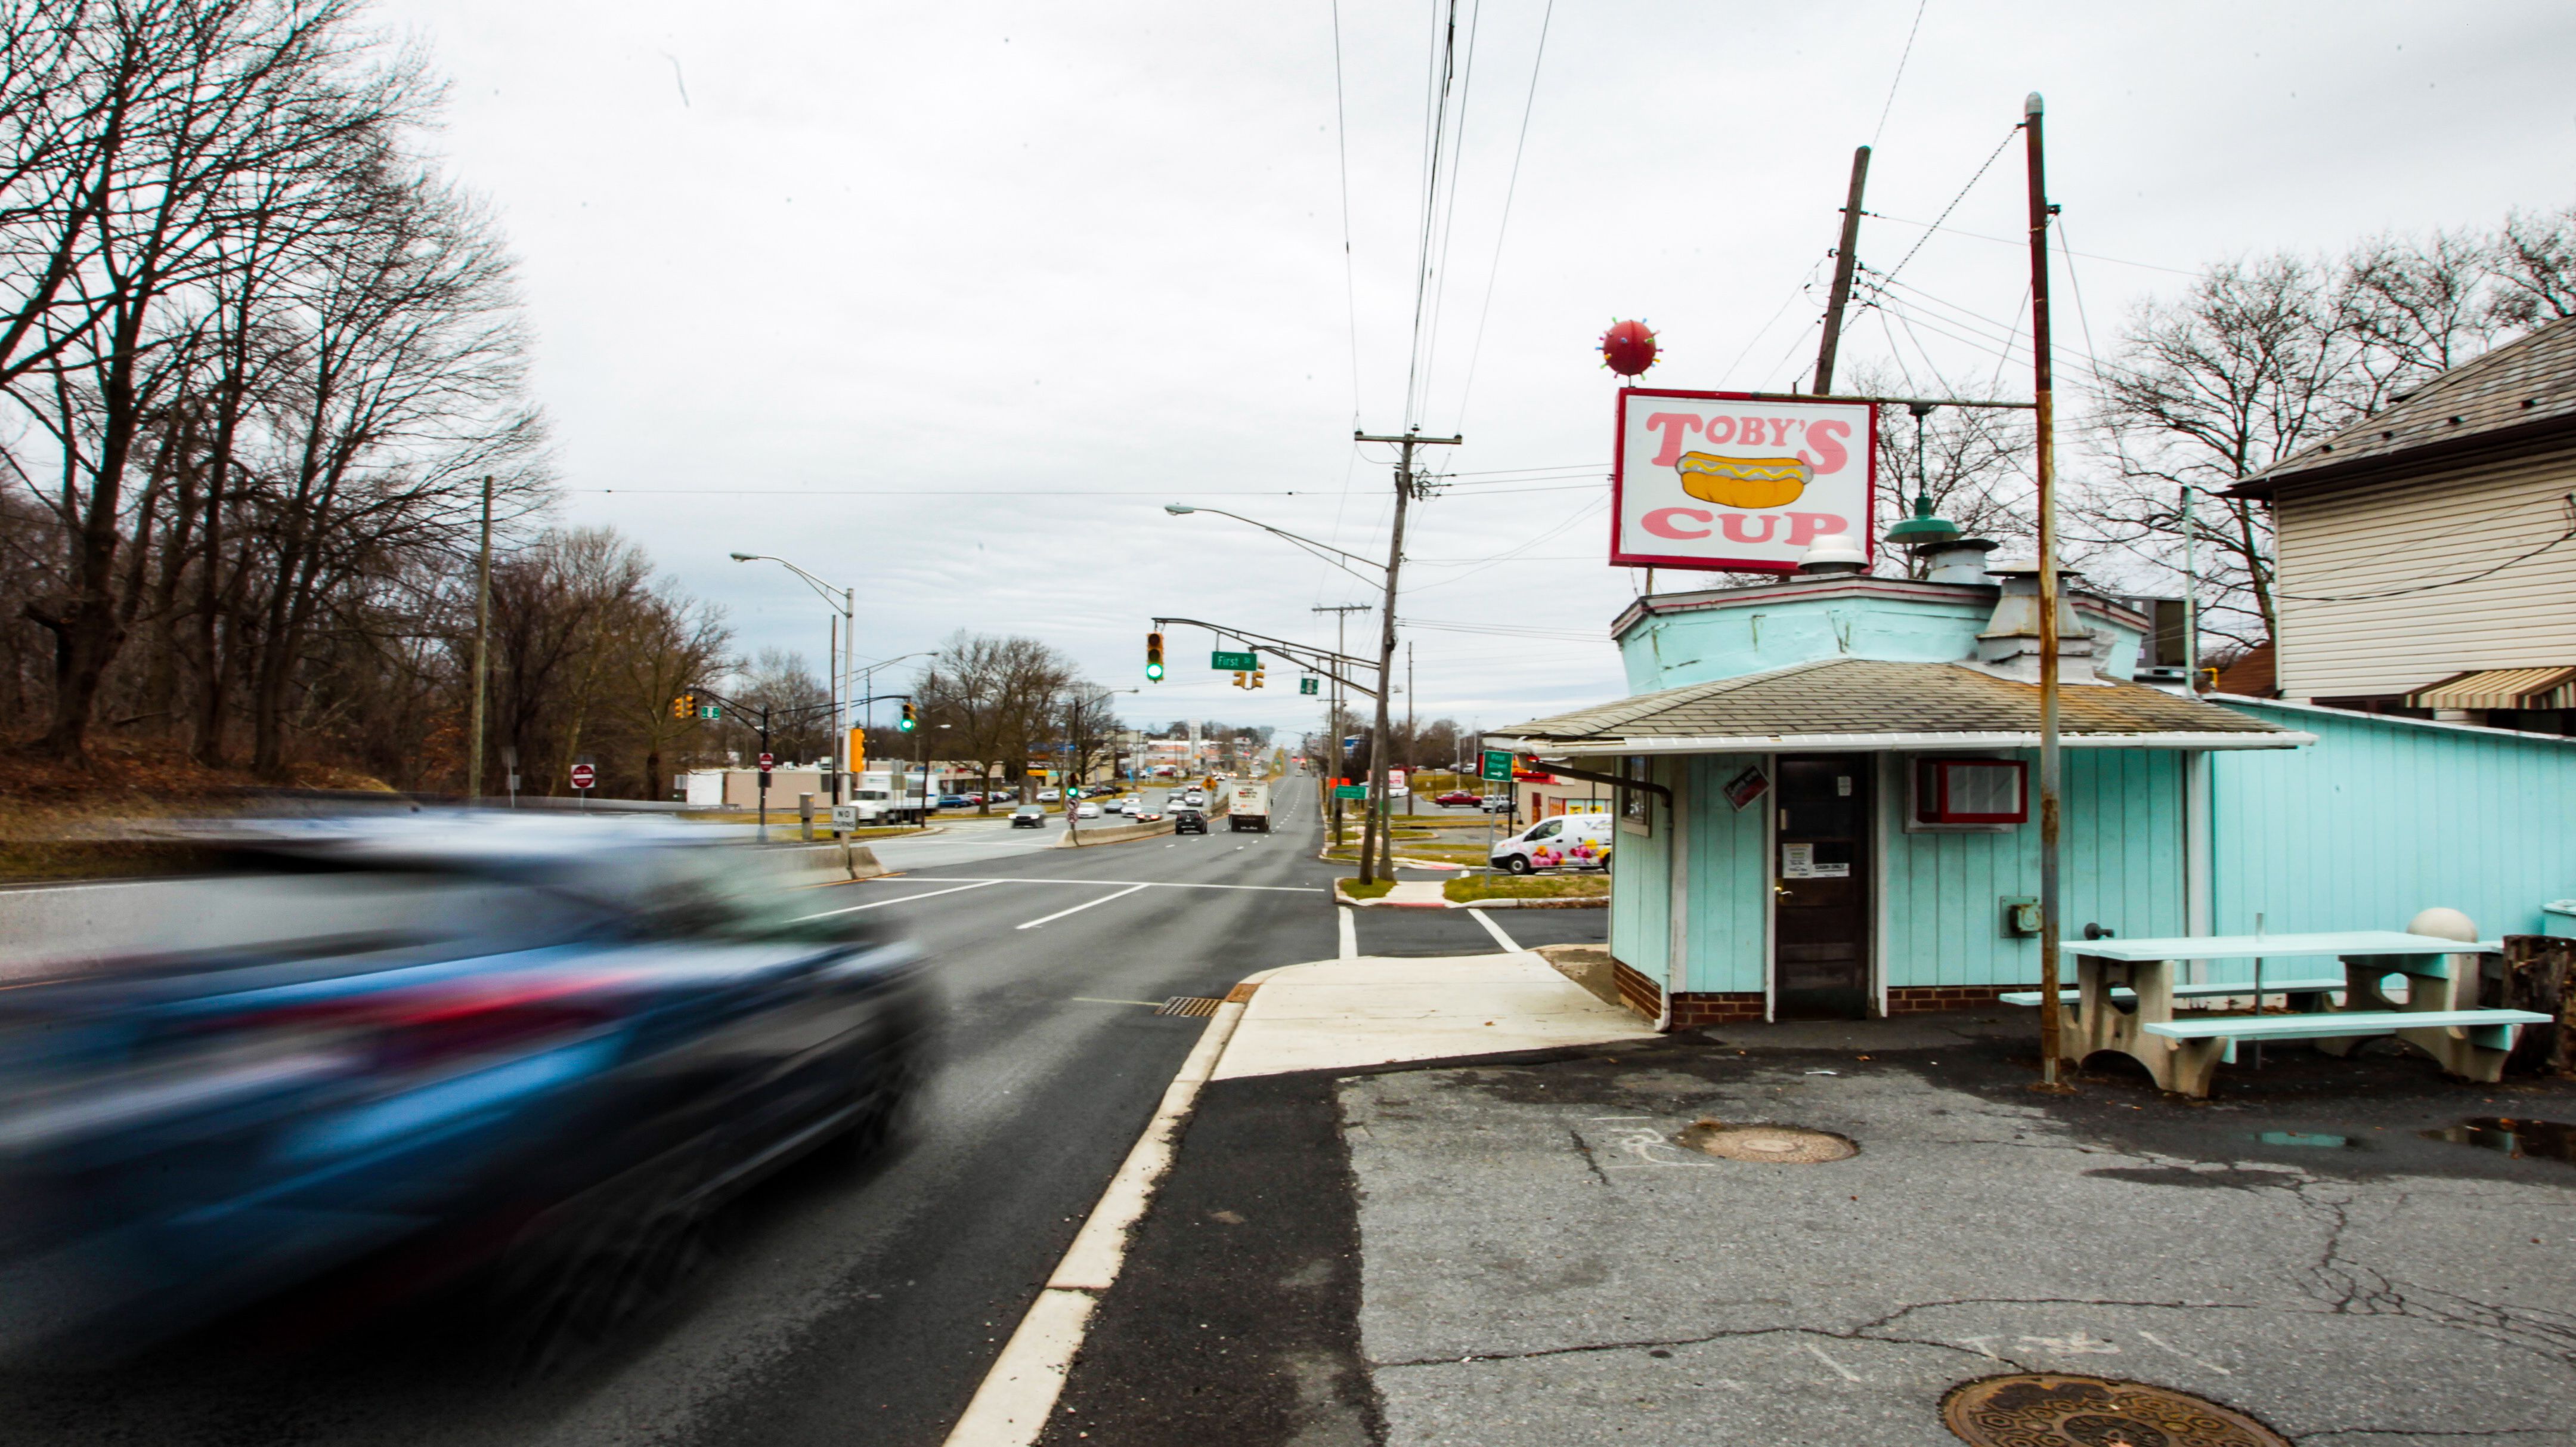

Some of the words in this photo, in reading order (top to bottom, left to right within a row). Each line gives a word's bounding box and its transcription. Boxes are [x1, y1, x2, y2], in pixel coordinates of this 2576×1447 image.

[1646, 412, 1852, 475] TOBY'S
[1641, 508, 1849, 546] CUP
[1217, 656, 1239, 667] First
